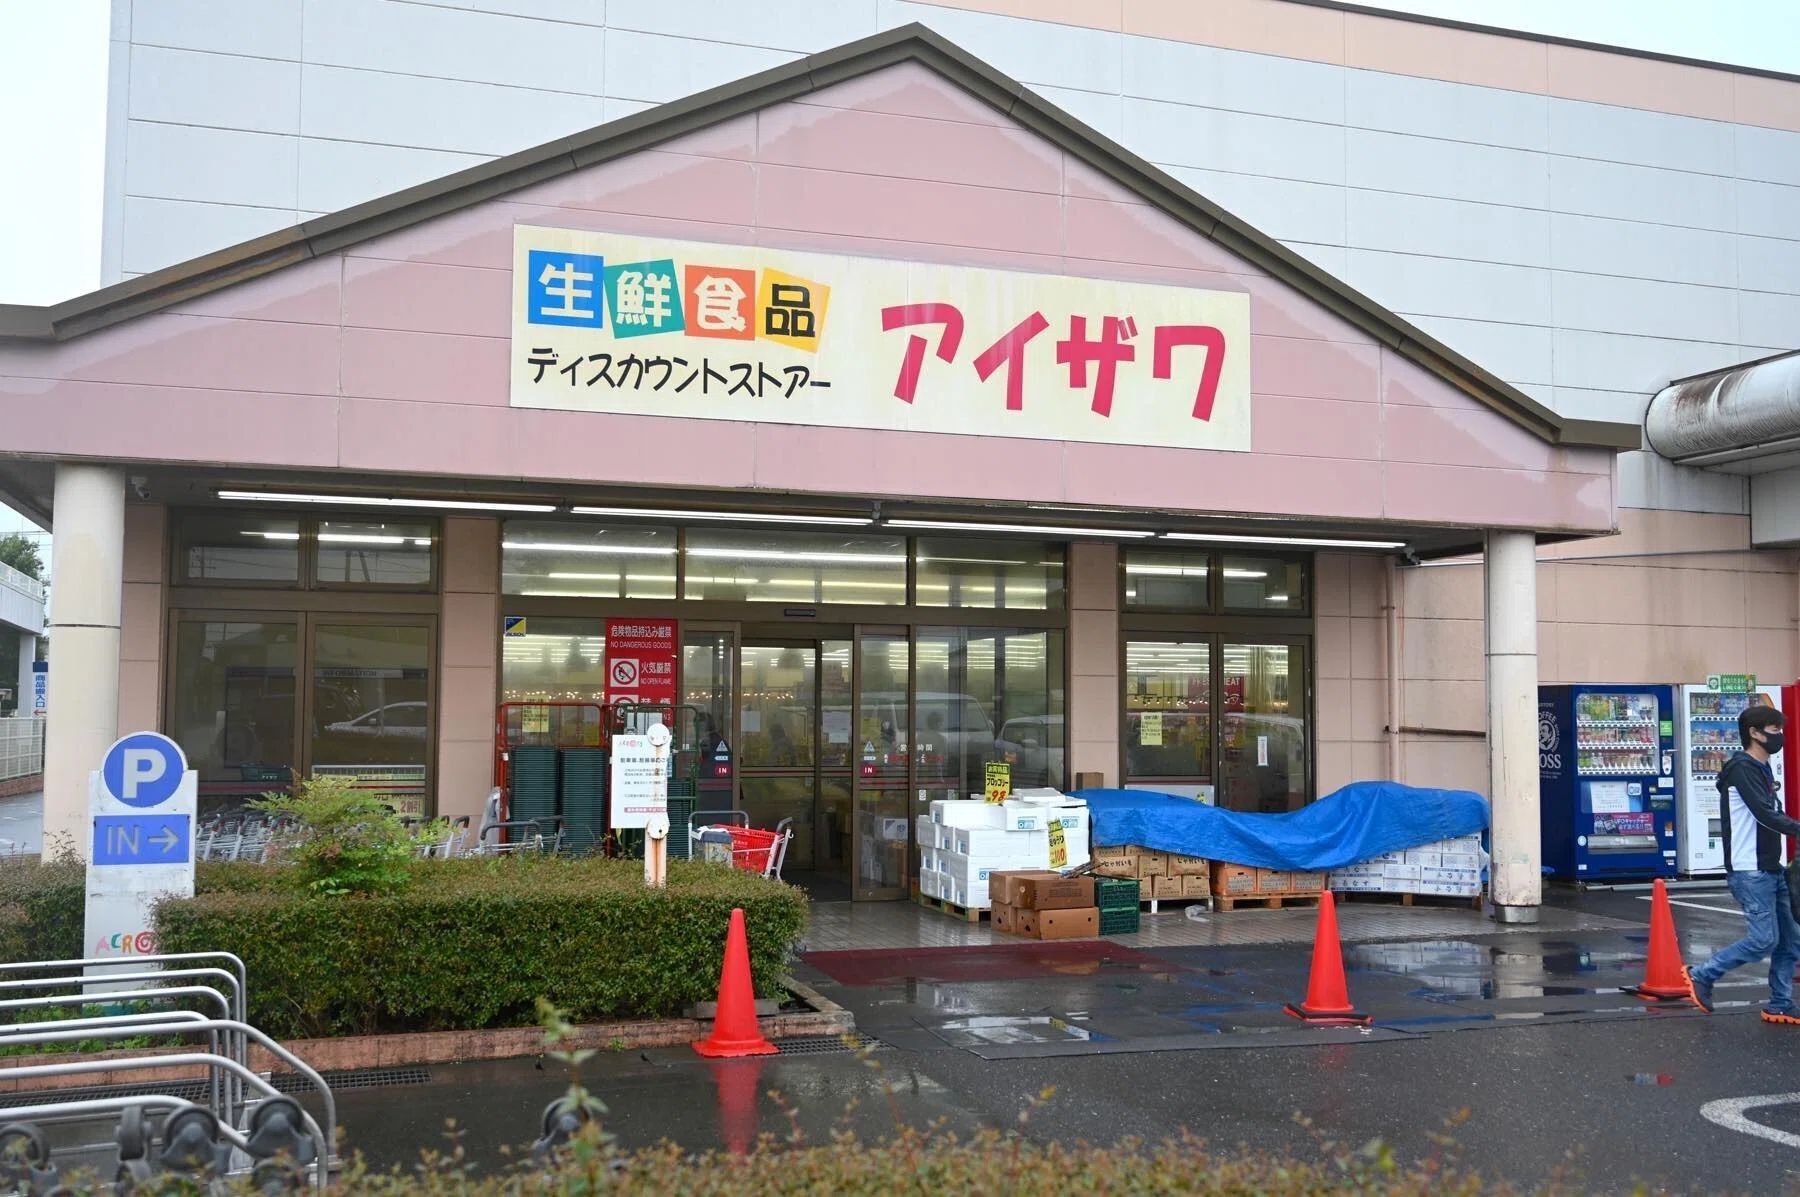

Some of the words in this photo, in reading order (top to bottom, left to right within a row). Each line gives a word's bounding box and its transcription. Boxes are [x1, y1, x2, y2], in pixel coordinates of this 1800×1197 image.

[538, 262, 816, 339] 生鮮食品
[881, 302, 1227, 422] アイザワ
[527, 347, 832, 400] ディスカウントストアー
[611, 625, 672, 638] 危険物品持込み厳禁
[653, 641, 672, 649] GOODS
[641, 662, 671, 674] 火気厳禁
[900, 743, 933, 752] 営時間
[1539, 753, 1562, 768] OSS
[122, 748, 167, 799] P
[991, 790, 1007, 801] 98
[107, 826, 140, 855] IN
